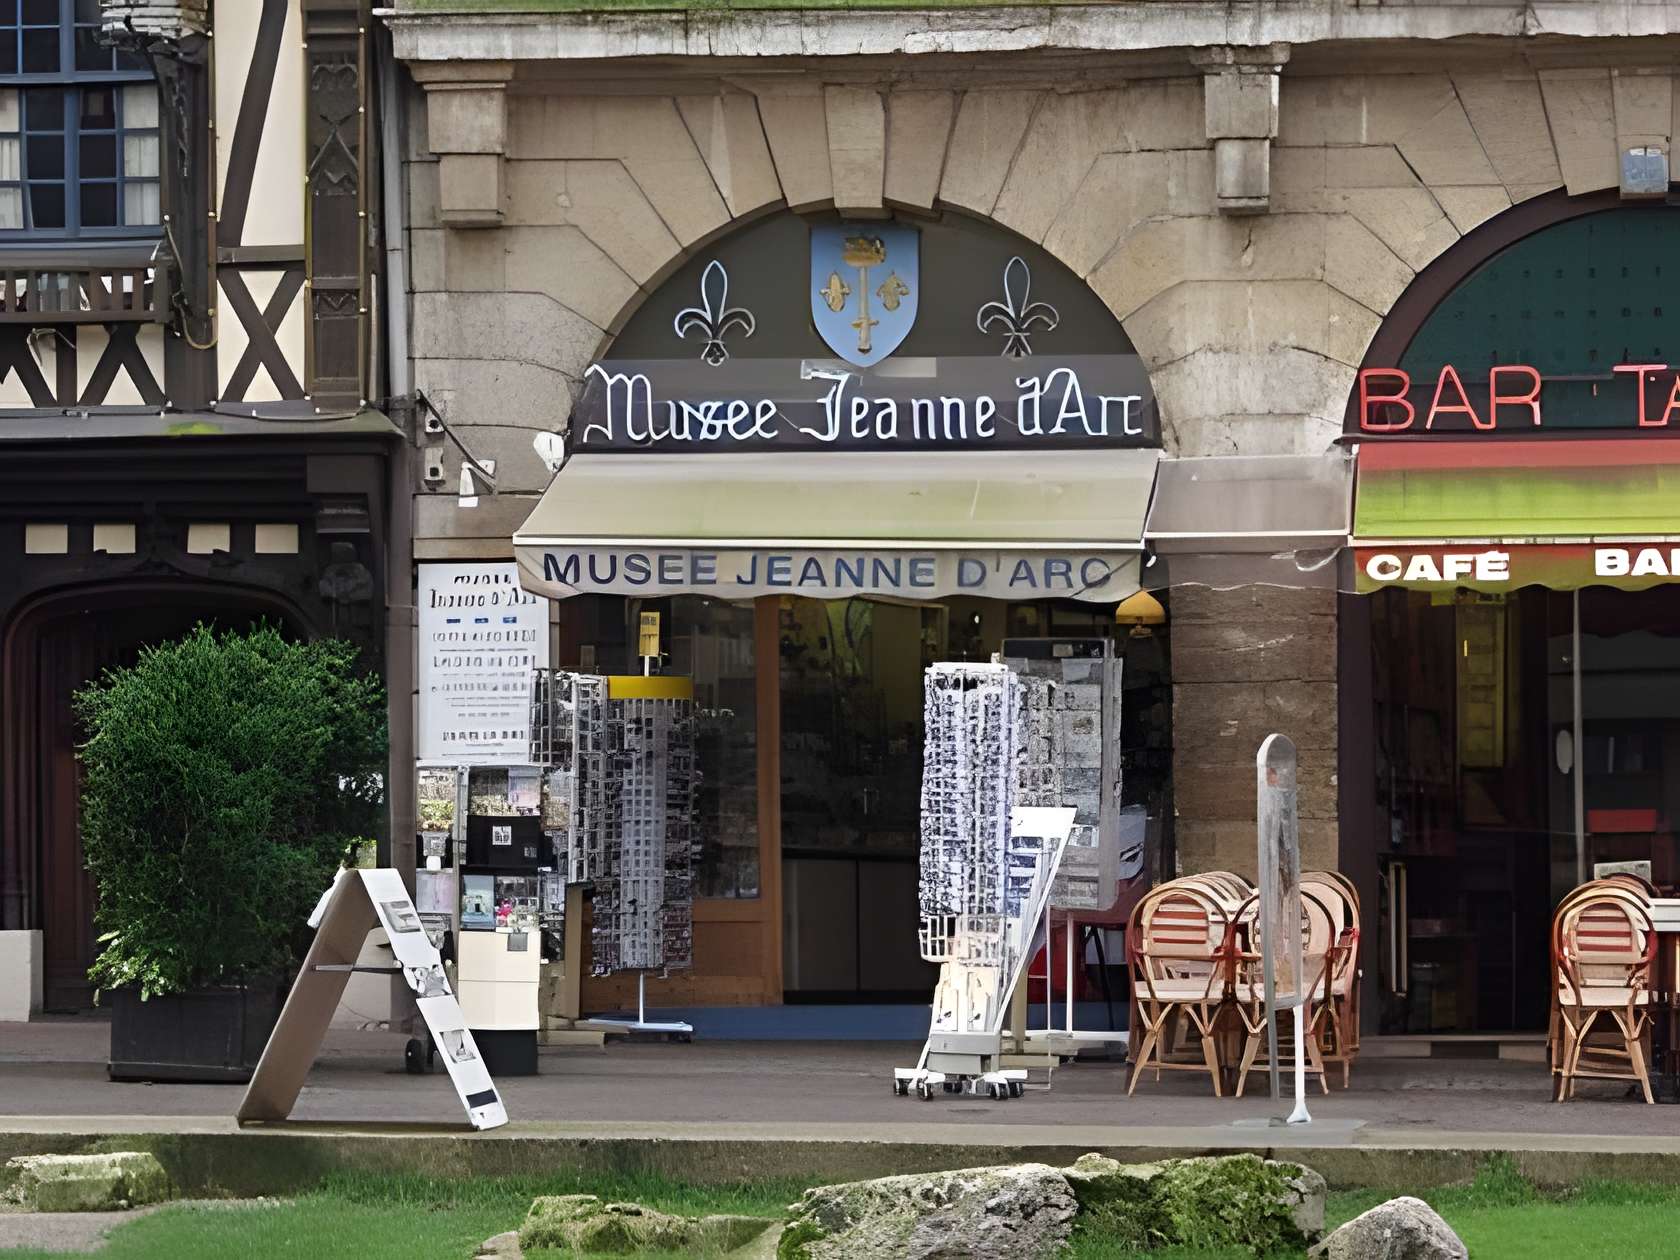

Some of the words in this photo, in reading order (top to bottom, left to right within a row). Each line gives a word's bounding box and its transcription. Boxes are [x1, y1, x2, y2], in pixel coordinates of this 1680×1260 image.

[800, 366, 996, 442] Jeanne
[1359, 364, 1542, 430] BAR
[543, 553, 717, 585] MUSEE
[736, 555, 936, 588] JEANNE
[957, 554, 1111, 589] D'ARC
[1595, 548, 1680, 576] BA
